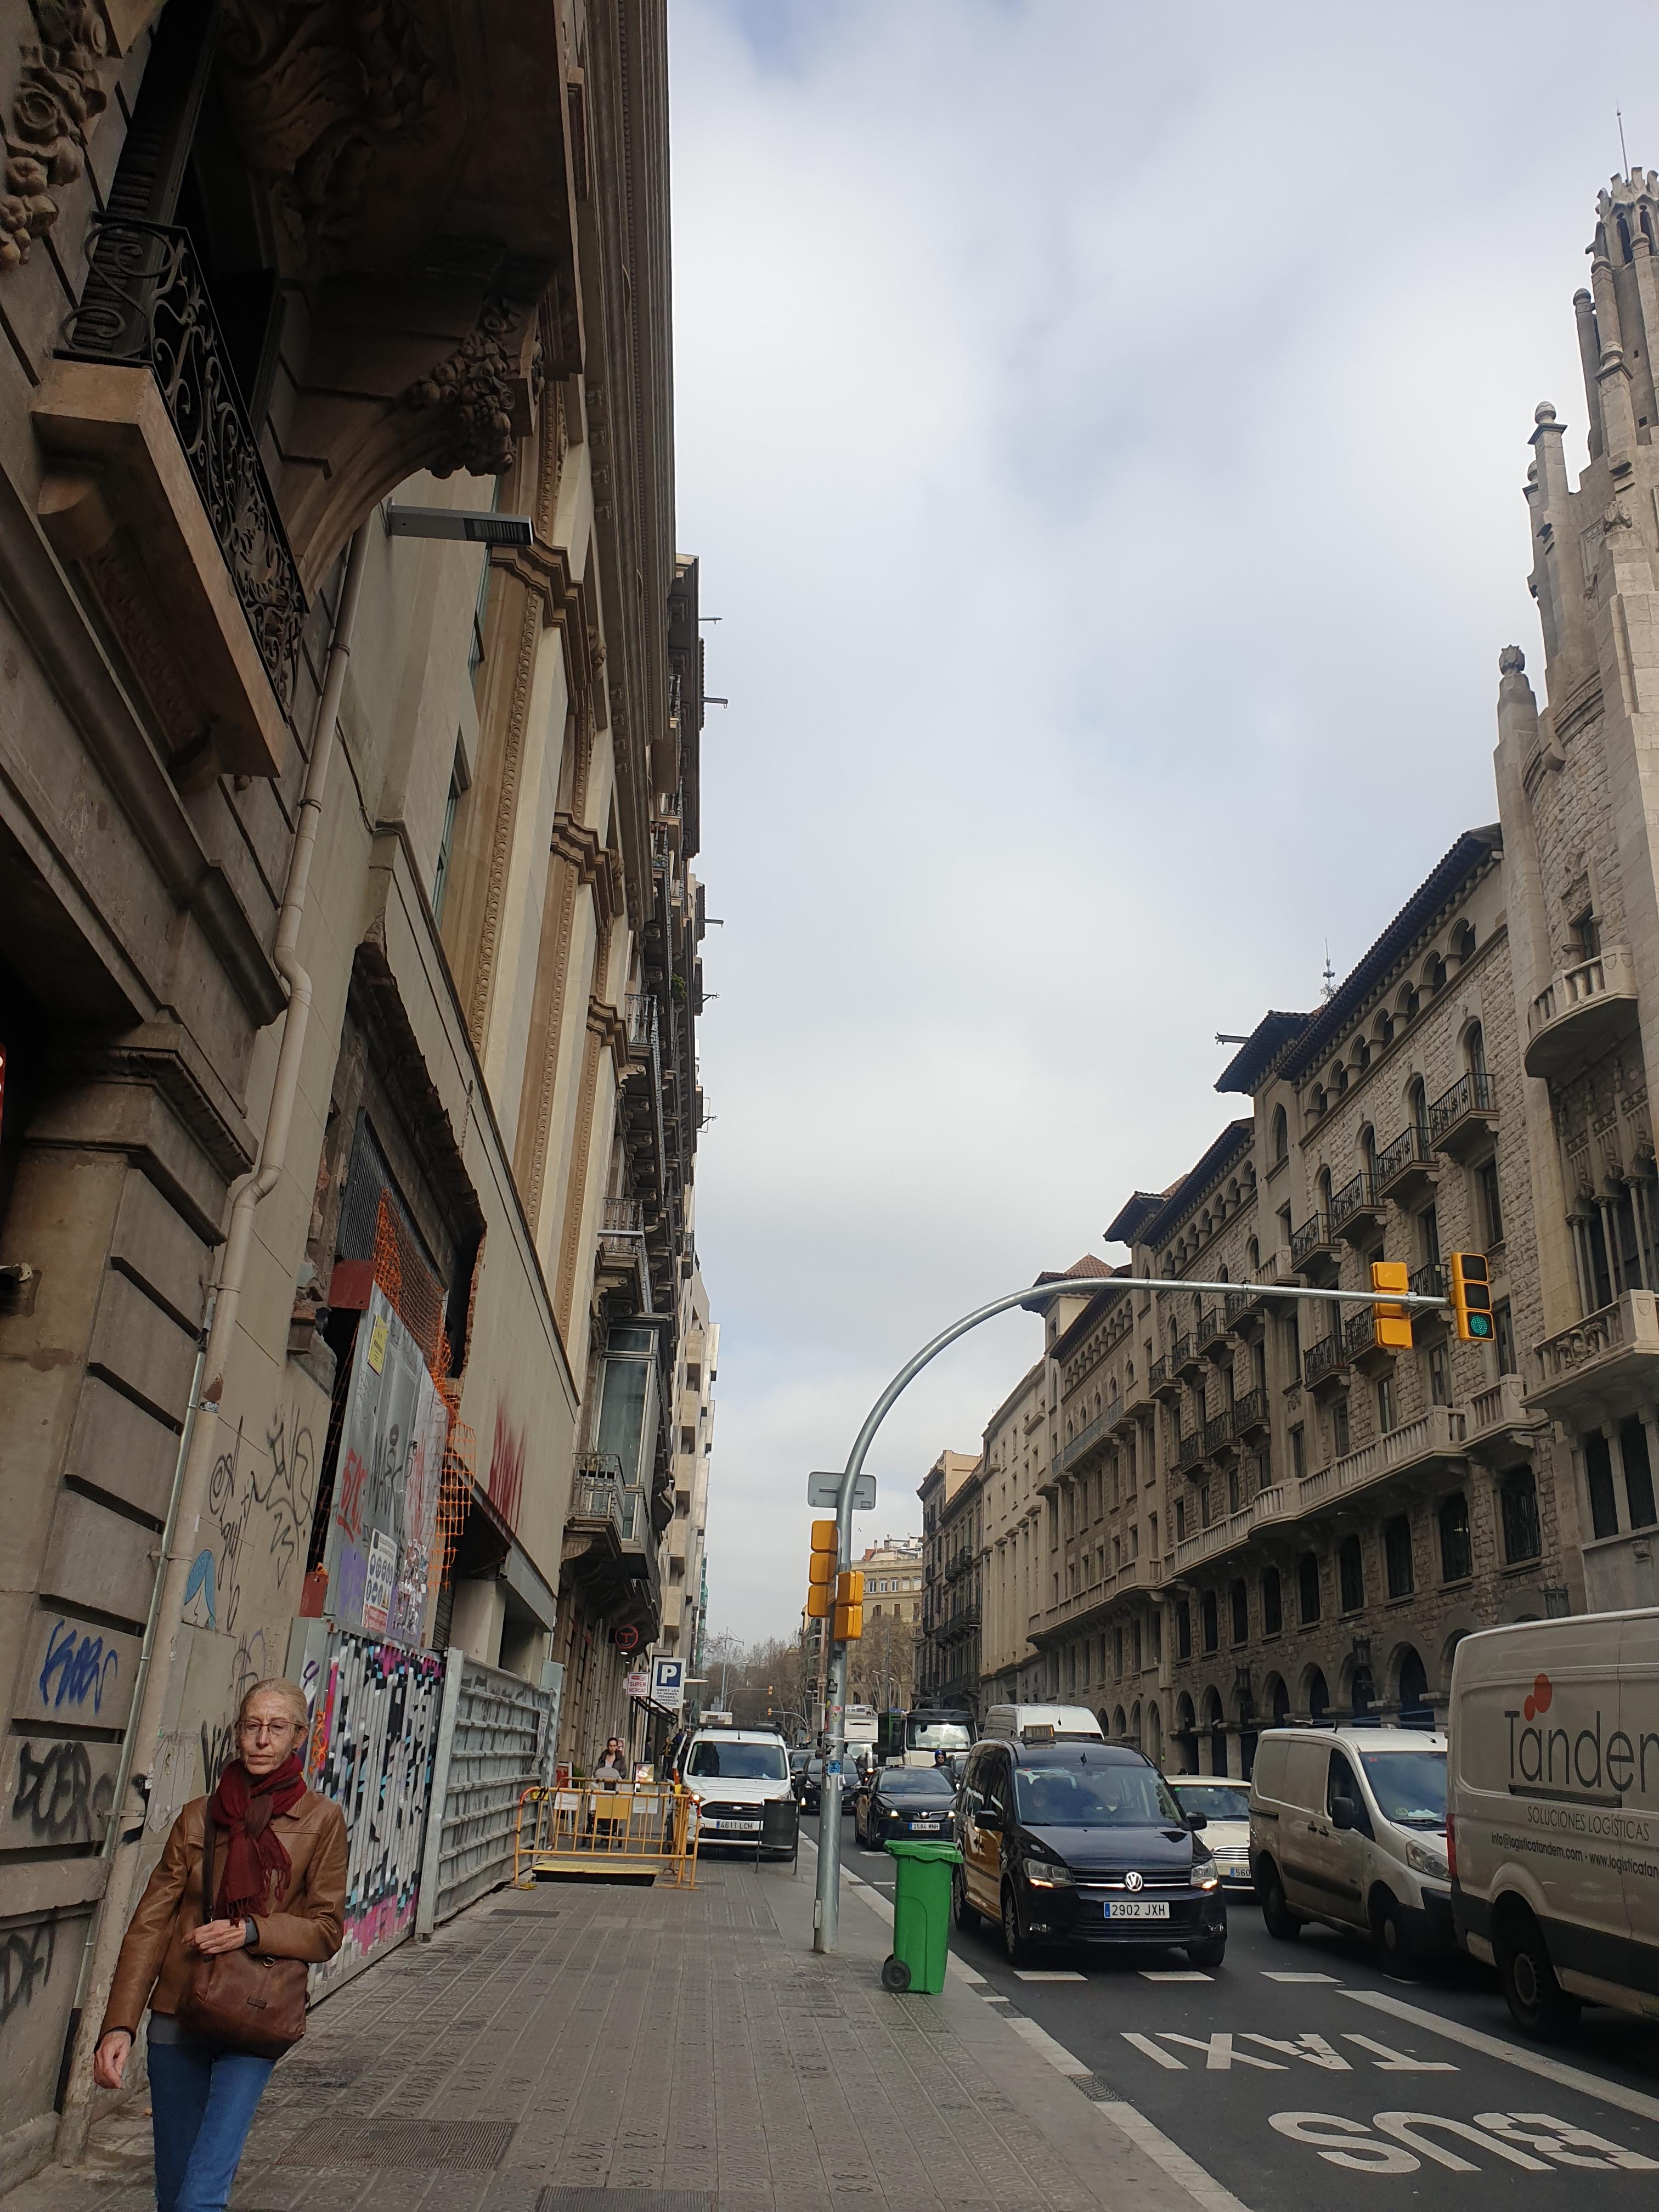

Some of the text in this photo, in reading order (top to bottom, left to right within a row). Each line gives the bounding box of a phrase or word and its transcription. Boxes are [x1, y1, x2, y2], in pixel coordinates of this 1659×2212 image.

[661, 1664, 678, 1684] P
[1527, 1805, 1650, 1842] SOLUCIONES LOGÍSTICAS
[1491, 1831, 1659, 1879] info@logisticatandem.com www.logisticatan
[1112, 1904, 1165, 1916] 2902 JXH
[1119, 2033, 1462, 2070] TAXI
[1268, 2111, 1659, 2173] BUS
